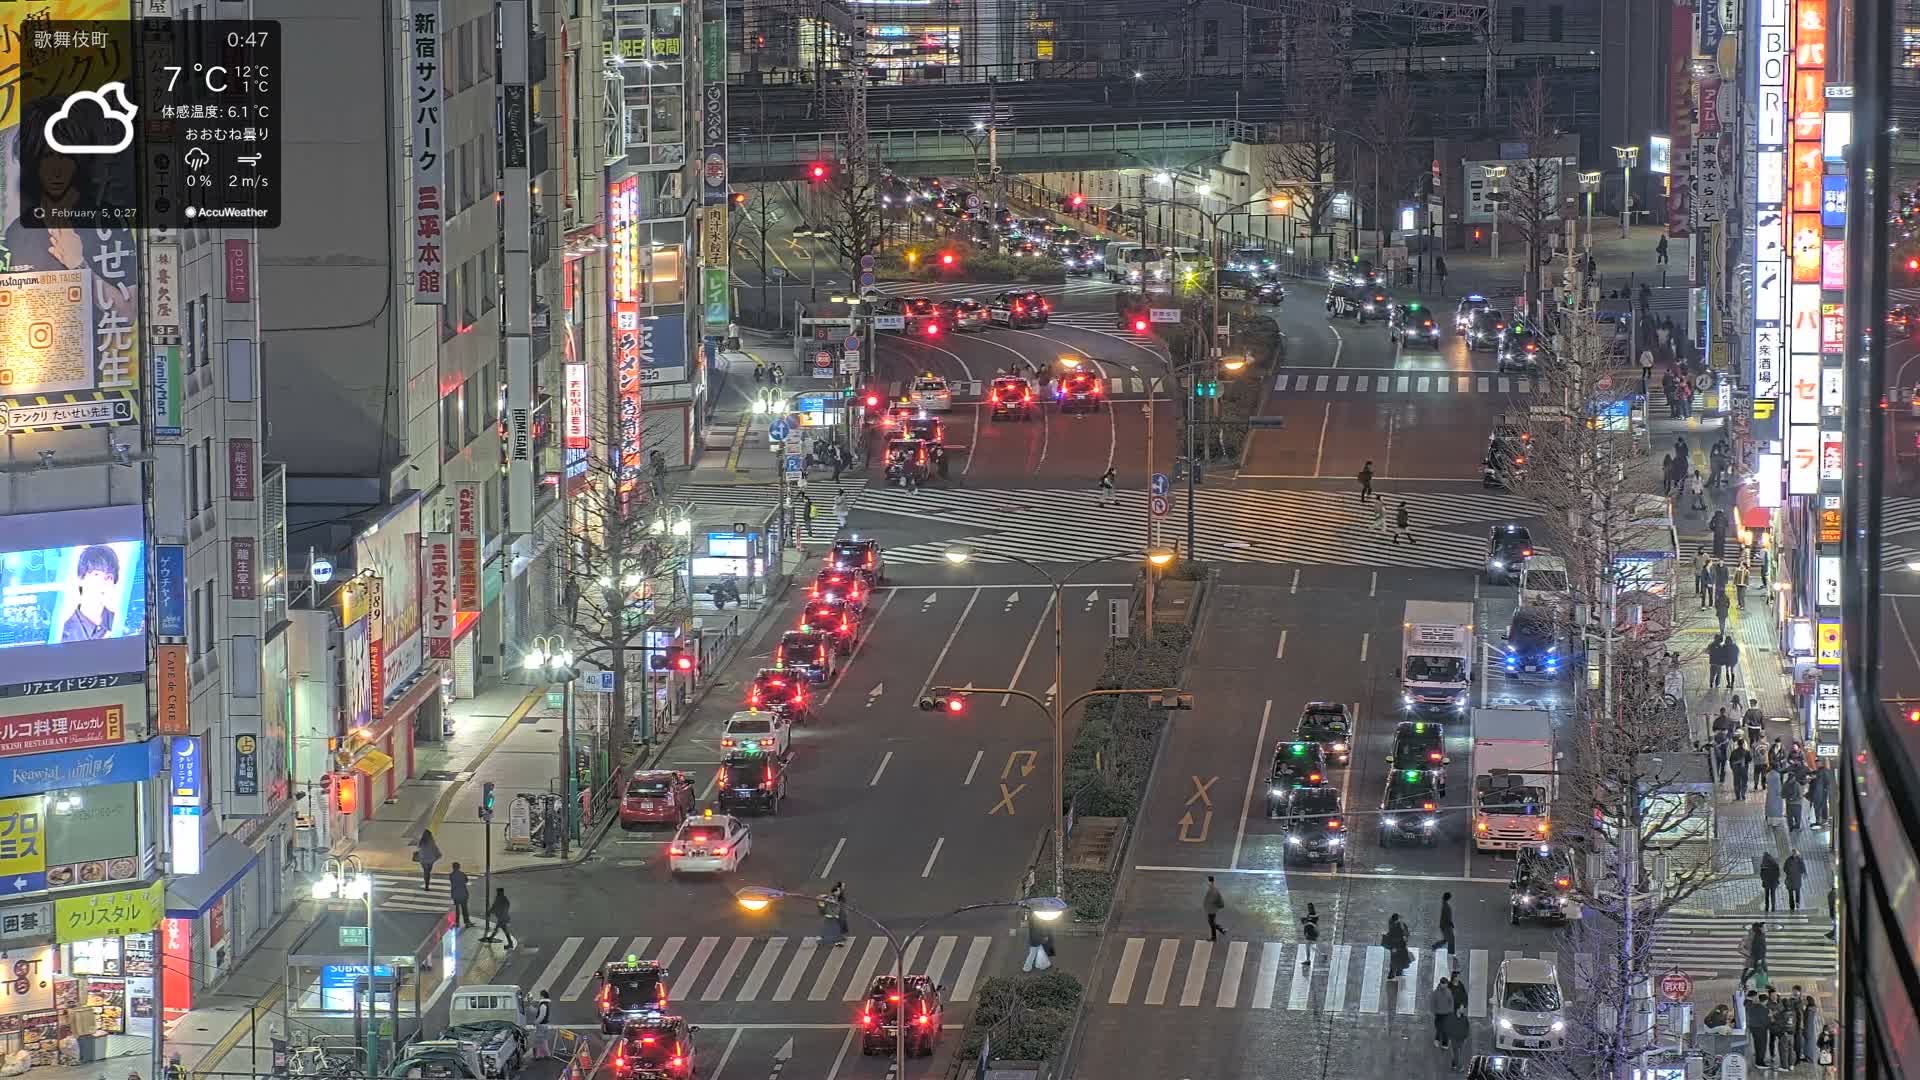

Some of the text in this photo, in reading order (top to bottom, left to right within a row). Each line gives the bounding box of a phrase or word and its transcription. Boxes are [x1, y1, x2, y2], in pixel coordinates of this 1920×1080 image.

[414, 12, 439, 172] 新宿サンパーク
[1704, 88, 1718, 121] アコム
[417, 185, 441, 294] 三平本館
[155, 354, 169, 417] FamilyMart
[1793, 310, 1818, 470] パセラ
[13, 406, 110, 424] テンクリ たいせい先生
[512, 408, 528, 462] HOMEGAME
[459, 488, 472, 534] GAME
[431, 543, 449, 632] 三平ストア
[167, 651, 177, 681] CAFE
[23, 675, 119, 696] リアエイド ビジョン
[69, 717, 104, 731] パムッカレ
[167, 695, 177, 722] CRIE
[24, 737, 69, 749] RESTAURANT
[3, 912, 39, 934] 囲碁
[69, 904, 141, 930] クリスタル
